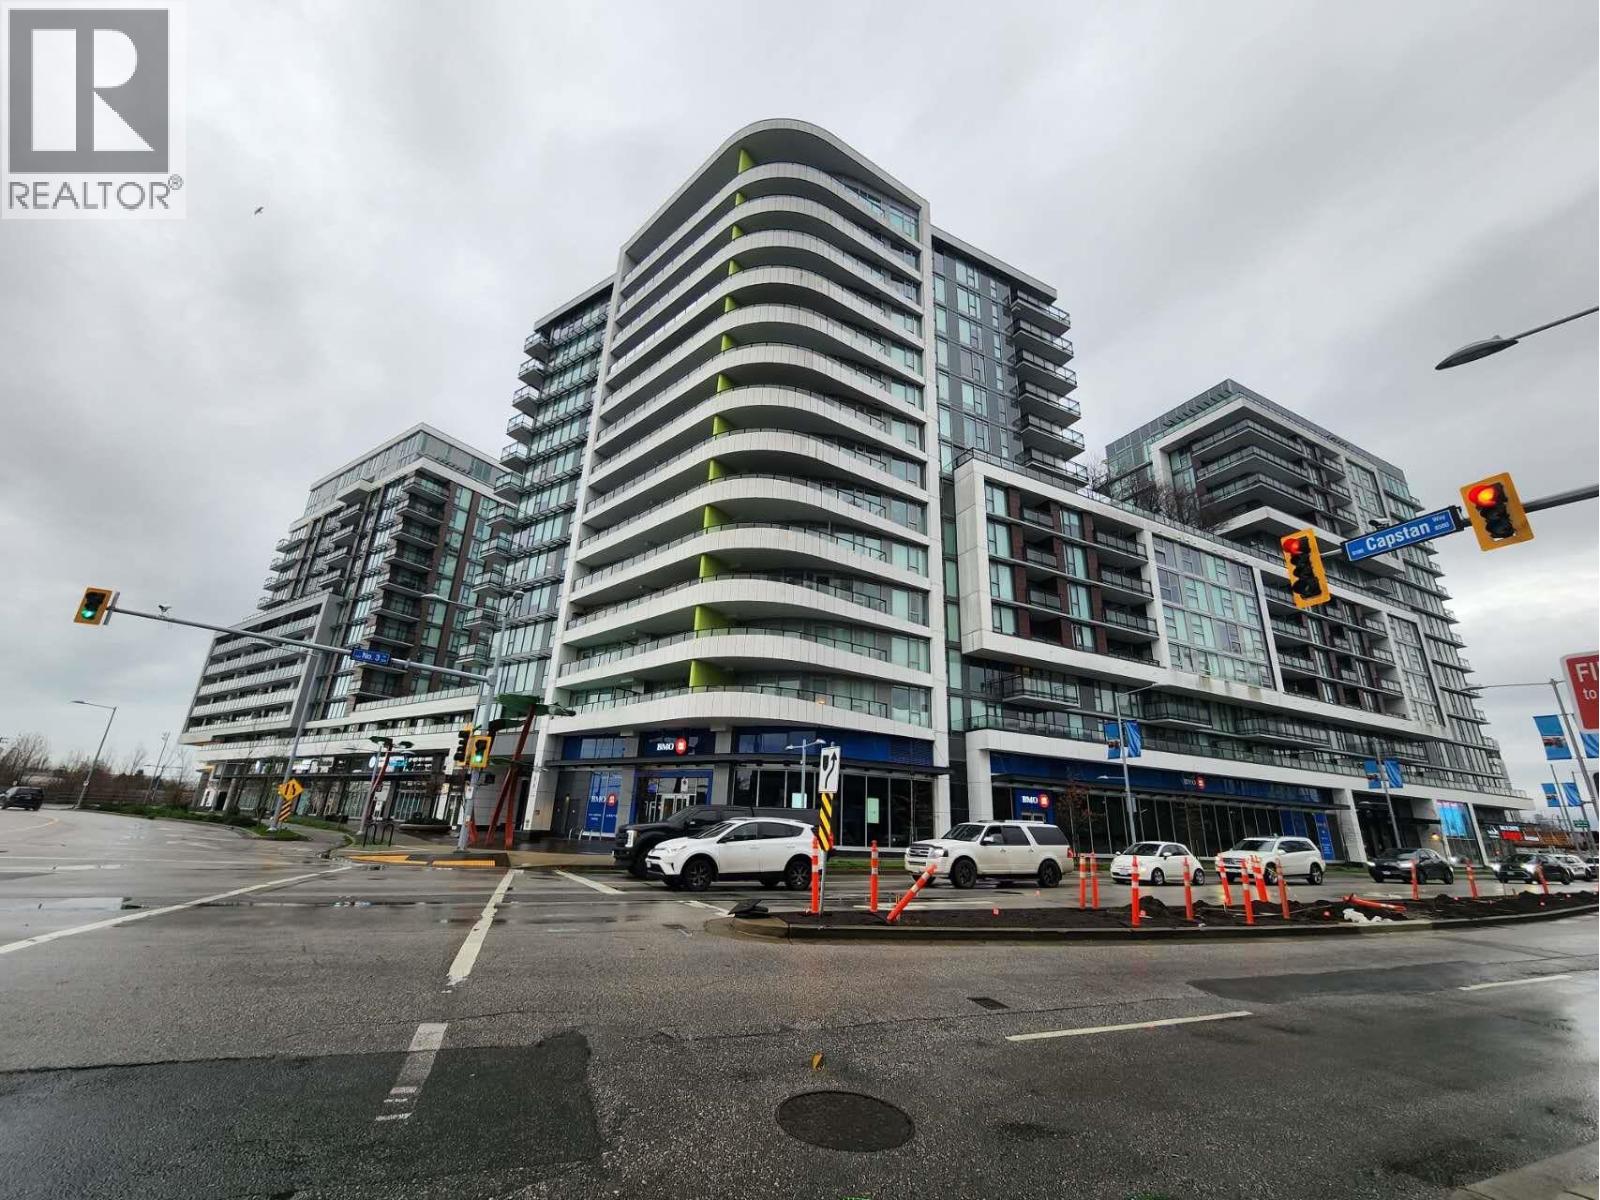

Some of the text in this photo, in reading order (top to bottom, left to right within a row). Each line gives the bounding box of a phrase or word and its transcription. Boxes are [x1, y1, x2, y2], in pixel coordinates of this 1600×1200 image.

[1366, 522, 1431, 551] Capstan
[374, 654, 380, 662] 3
[1583, 688, 1597, 700] to
[656, 742, 675, 751] BMO
[1021, 795, 1039, 804] BMO
